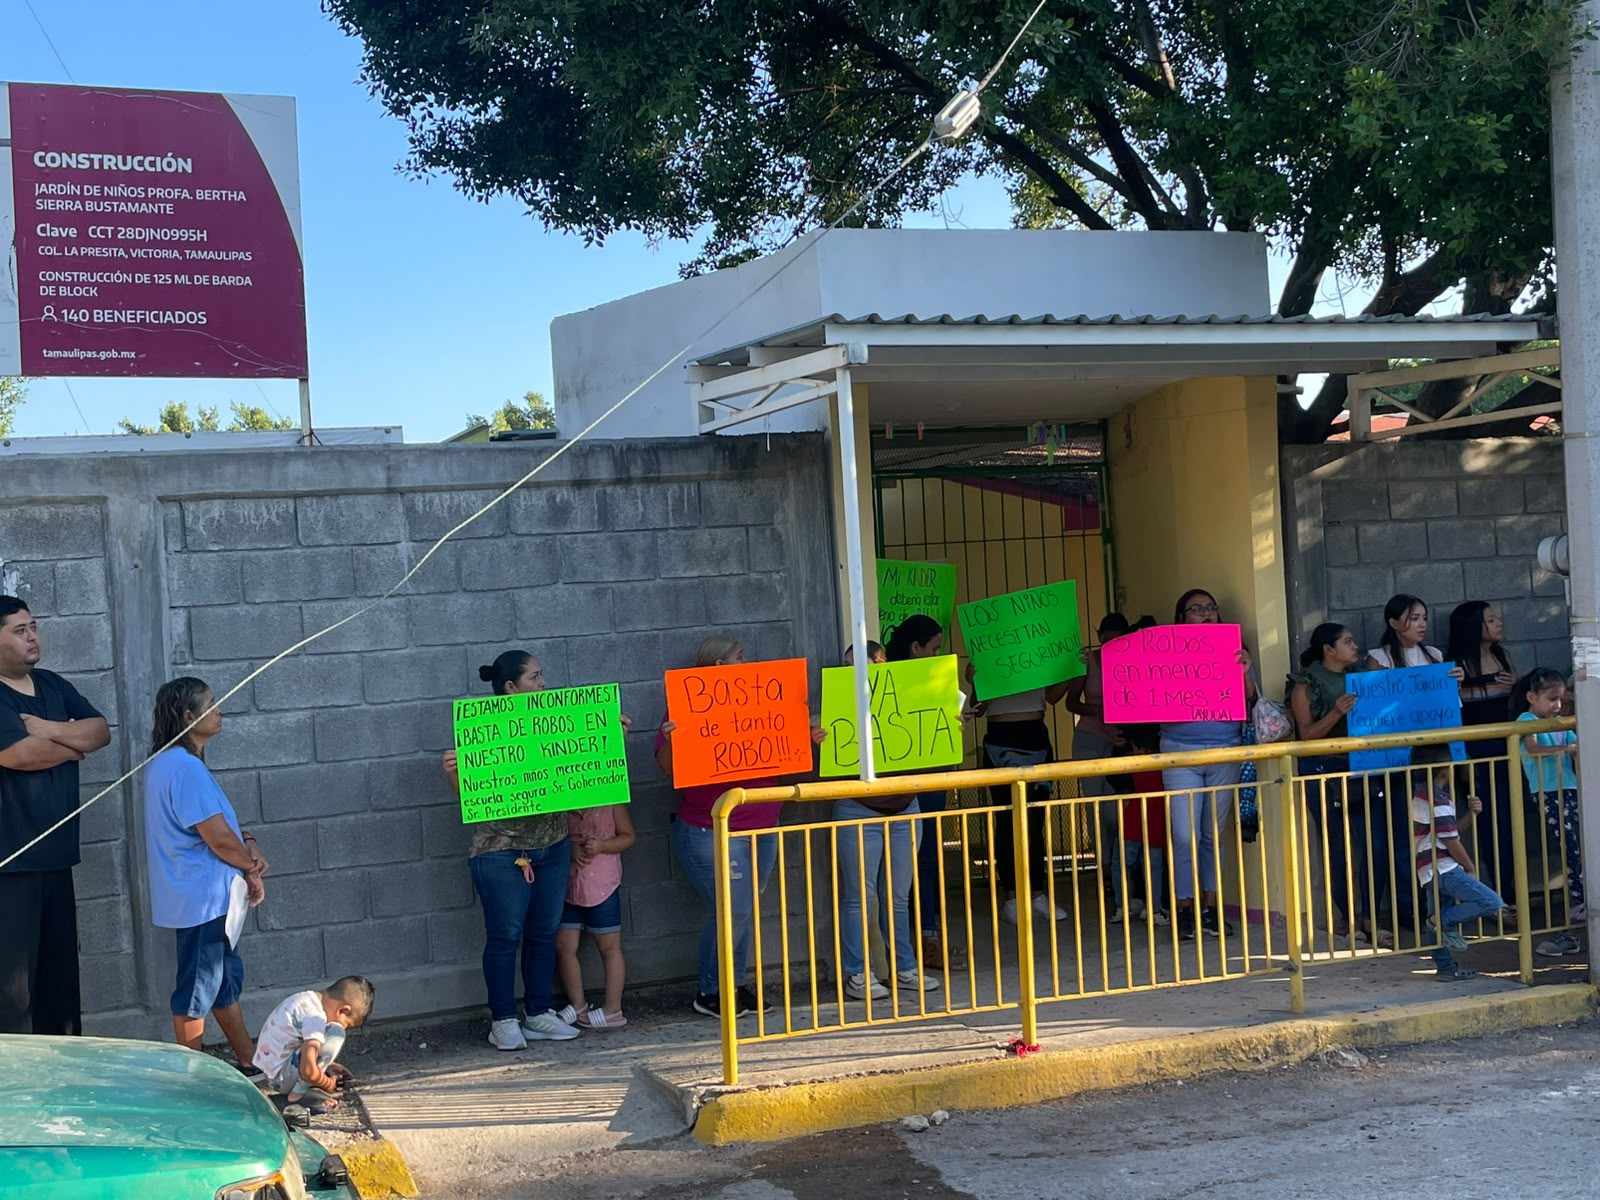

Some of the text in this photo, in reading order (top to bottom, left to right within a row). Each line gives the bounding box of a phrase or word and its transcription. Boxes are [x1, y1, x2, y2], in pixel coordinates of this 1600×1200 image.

[33, 151, 193, 174] CONSTRUCCIÓN
[35, 182, 247, 202] JARDÍN DE NIÑOS PROFA. BERTHA
[35, 199, 175, 215] SIERRA BUSTAMANTE
[36, 223, 208, 243] Clave CCT 28DJN0995H
[38, 245, 253, 262] COL. LA PRESITA, VICTORIA, TAMAULIPAS
[39, 270, 253, 287] CONSTRUCCIÓN DE 125 ML DE BARDA
[39, 285, 98, 298] DE BLOCK
[60, 309, 208, 324] 140 BENEFICIADOS
[42, 348, 136, 361] tamaulipas.gob.mx
[683, 674, 784, 714] Basta
[509, 718, 528, 739] DE
[532, 714, 575, 736] ROBOS
[585, 710, 608, 731] EN
[699, 711, 785, 738] de tanto
[830, 706, 955, 768] BASTA
[464, 735, 608, 769] NUESTRO KINDER!
